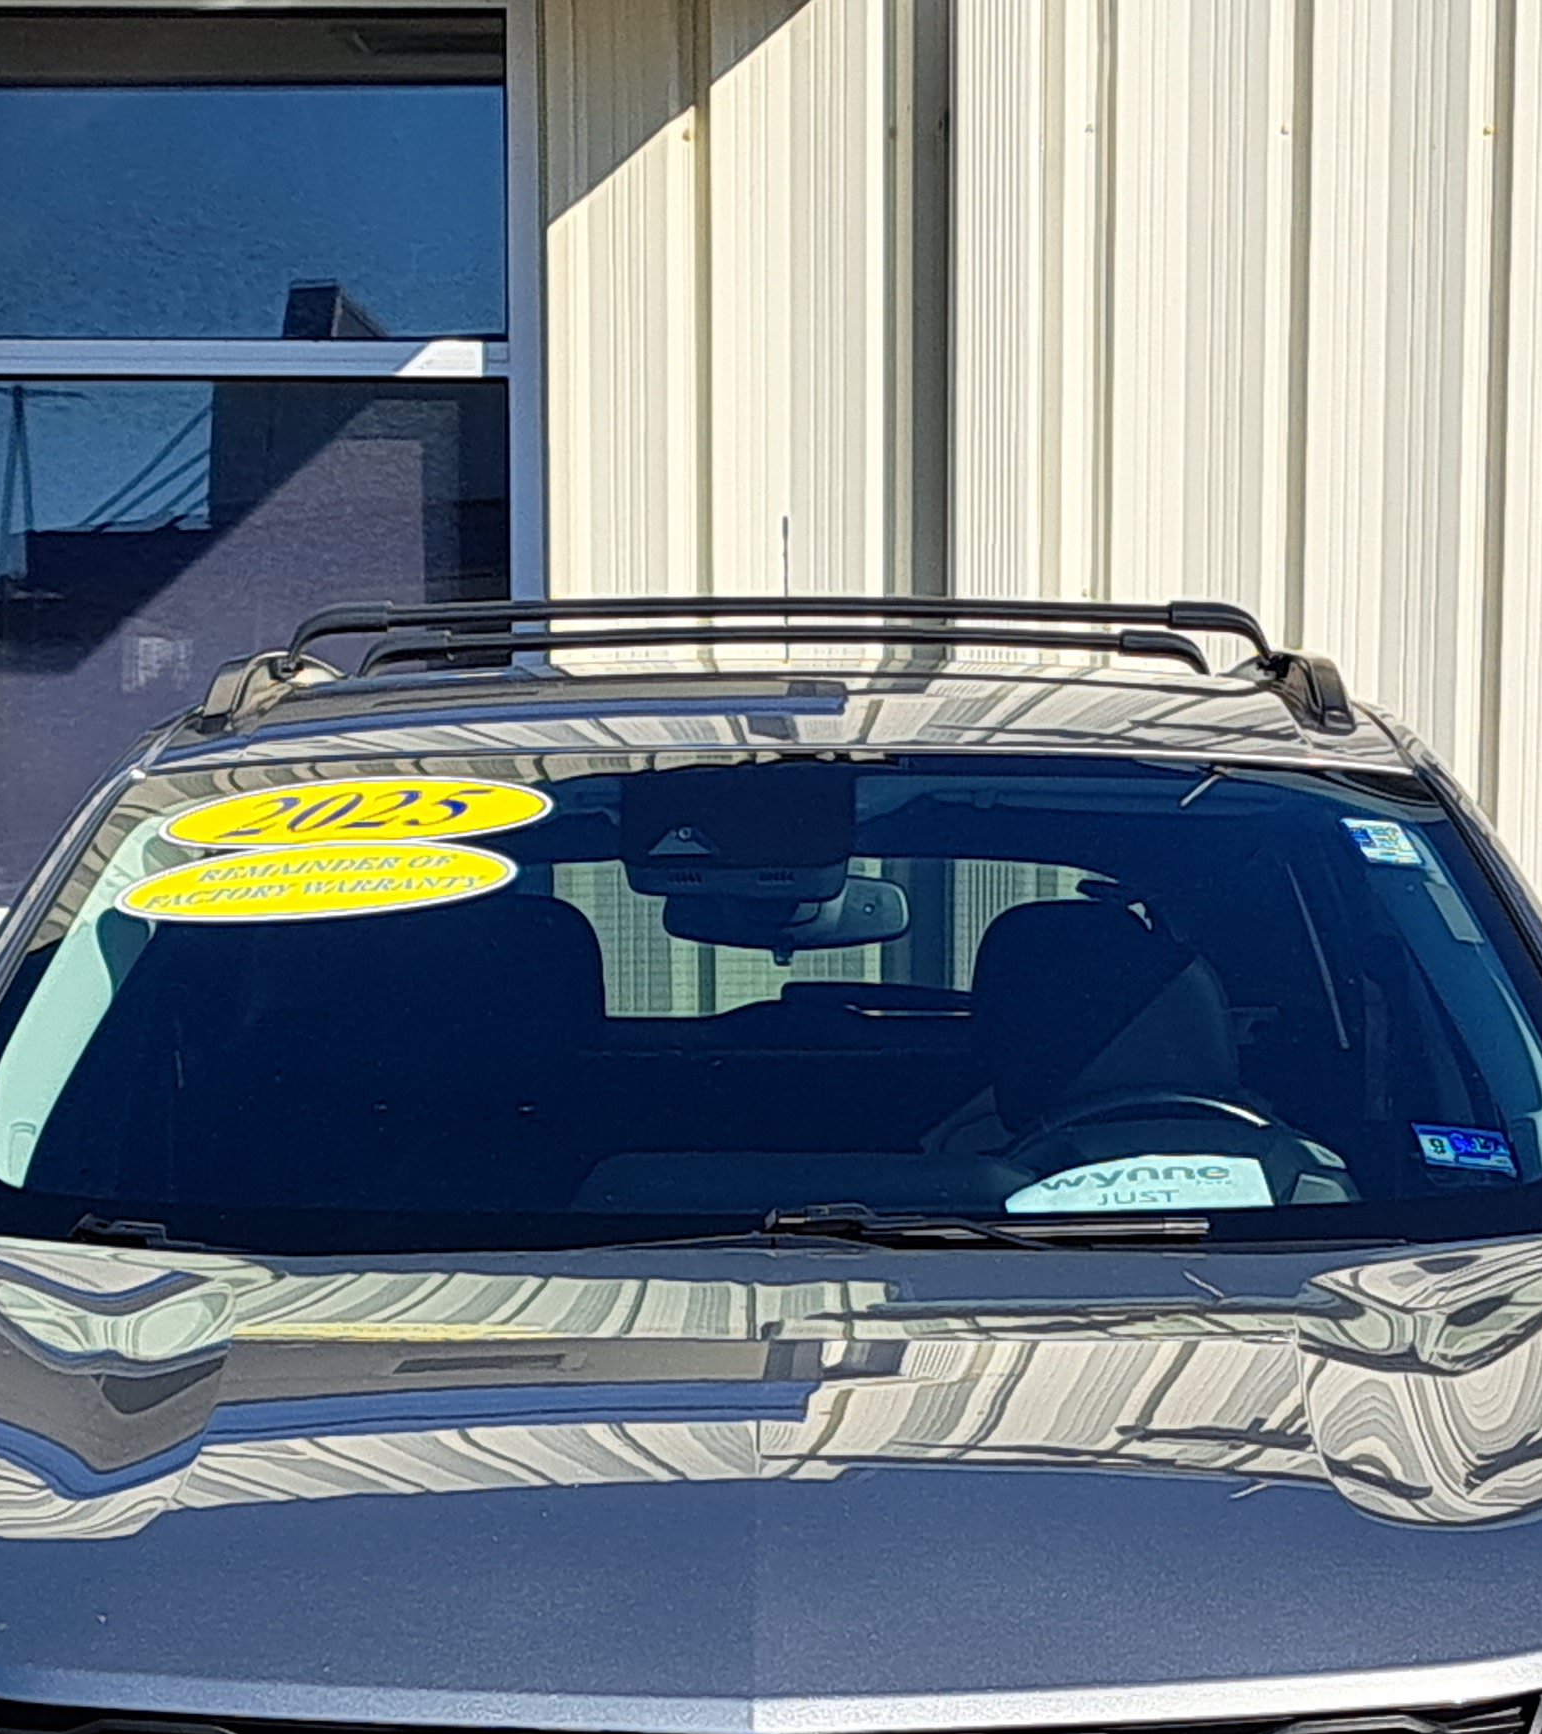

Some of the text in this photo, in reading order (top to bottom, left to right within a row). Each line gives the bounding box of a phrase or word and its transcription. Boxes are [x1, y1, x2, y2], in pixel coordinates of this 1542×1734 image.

[214, 788, 496, 838] 2025
[198, 853, 459, 883] REMAINDER OF
[144, 874, 487, 909] FACTORY WARRANTY
[1040, 1165, 1231, 1191] wynne
[1097, 1189, 1180, 1206] JUST
